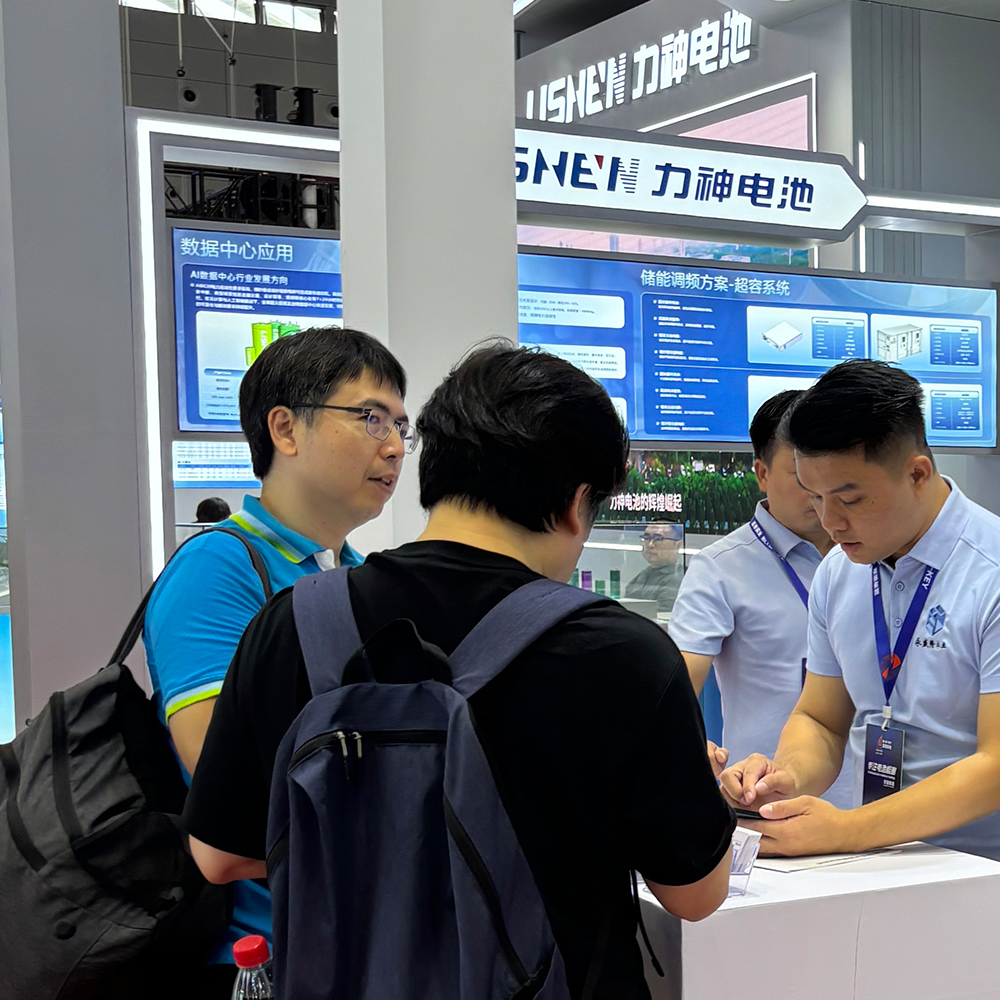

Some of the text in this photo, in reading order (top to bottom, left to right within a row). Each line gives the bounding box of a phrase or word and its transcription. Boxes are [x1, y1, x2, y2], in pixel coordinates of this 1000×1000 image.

[632, 9, 752, 100] 力神电池
[651, 163, 814, 212] 力神电池
[180, 237, 294, 262] 数据中心应用
[190, 270, 288, 285] AI数据中心行业发展方向
[641, 269, 790, 296] 储能调频方案-超容系统
